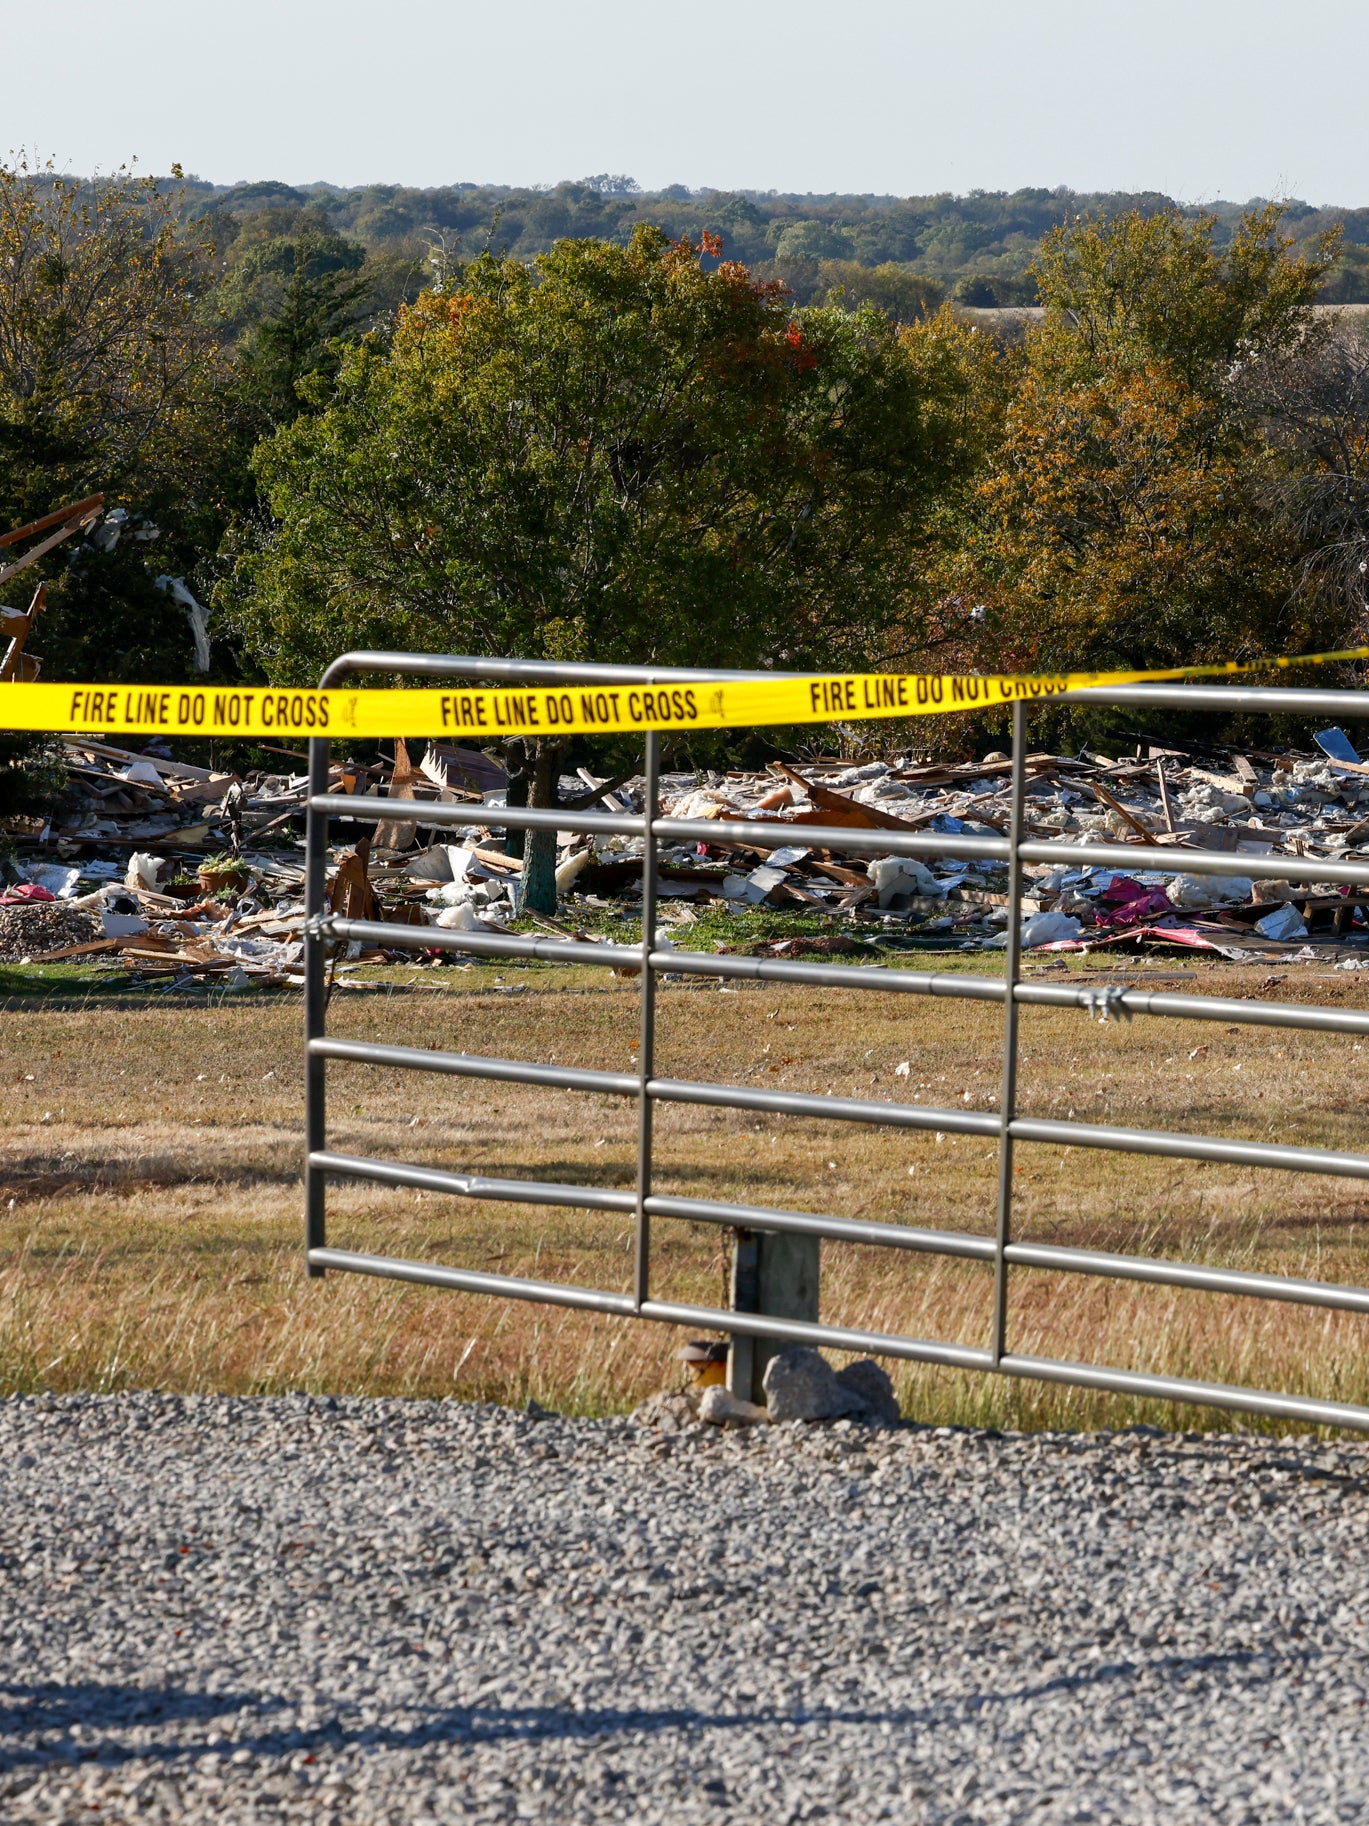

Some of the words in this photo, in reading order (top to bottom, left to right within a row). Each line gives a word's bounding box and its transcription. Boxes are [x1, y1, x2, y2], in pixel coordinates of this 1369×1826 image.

[70, 691, 118, 722] FIRE
[125, 693, 170, 724] LINE
[178, 694, 205, 726] DO
[213, 695, 254, 727] NOT
[261, 696, 330, 728] CROSS
[440, 696, 487, 727] FIRE
[494, 696, 540, 726] LINE
[546, 694, 574, 724] DO
[581, 693, 621, 723] NOT
[628, 690, 698, 722] CROSS
[810, 682, 856, 713] FIRE
[864, 679, 908, 709] LINE
[916, 677, 944, 704] DO
[952, 677, 989, 701] NOT
